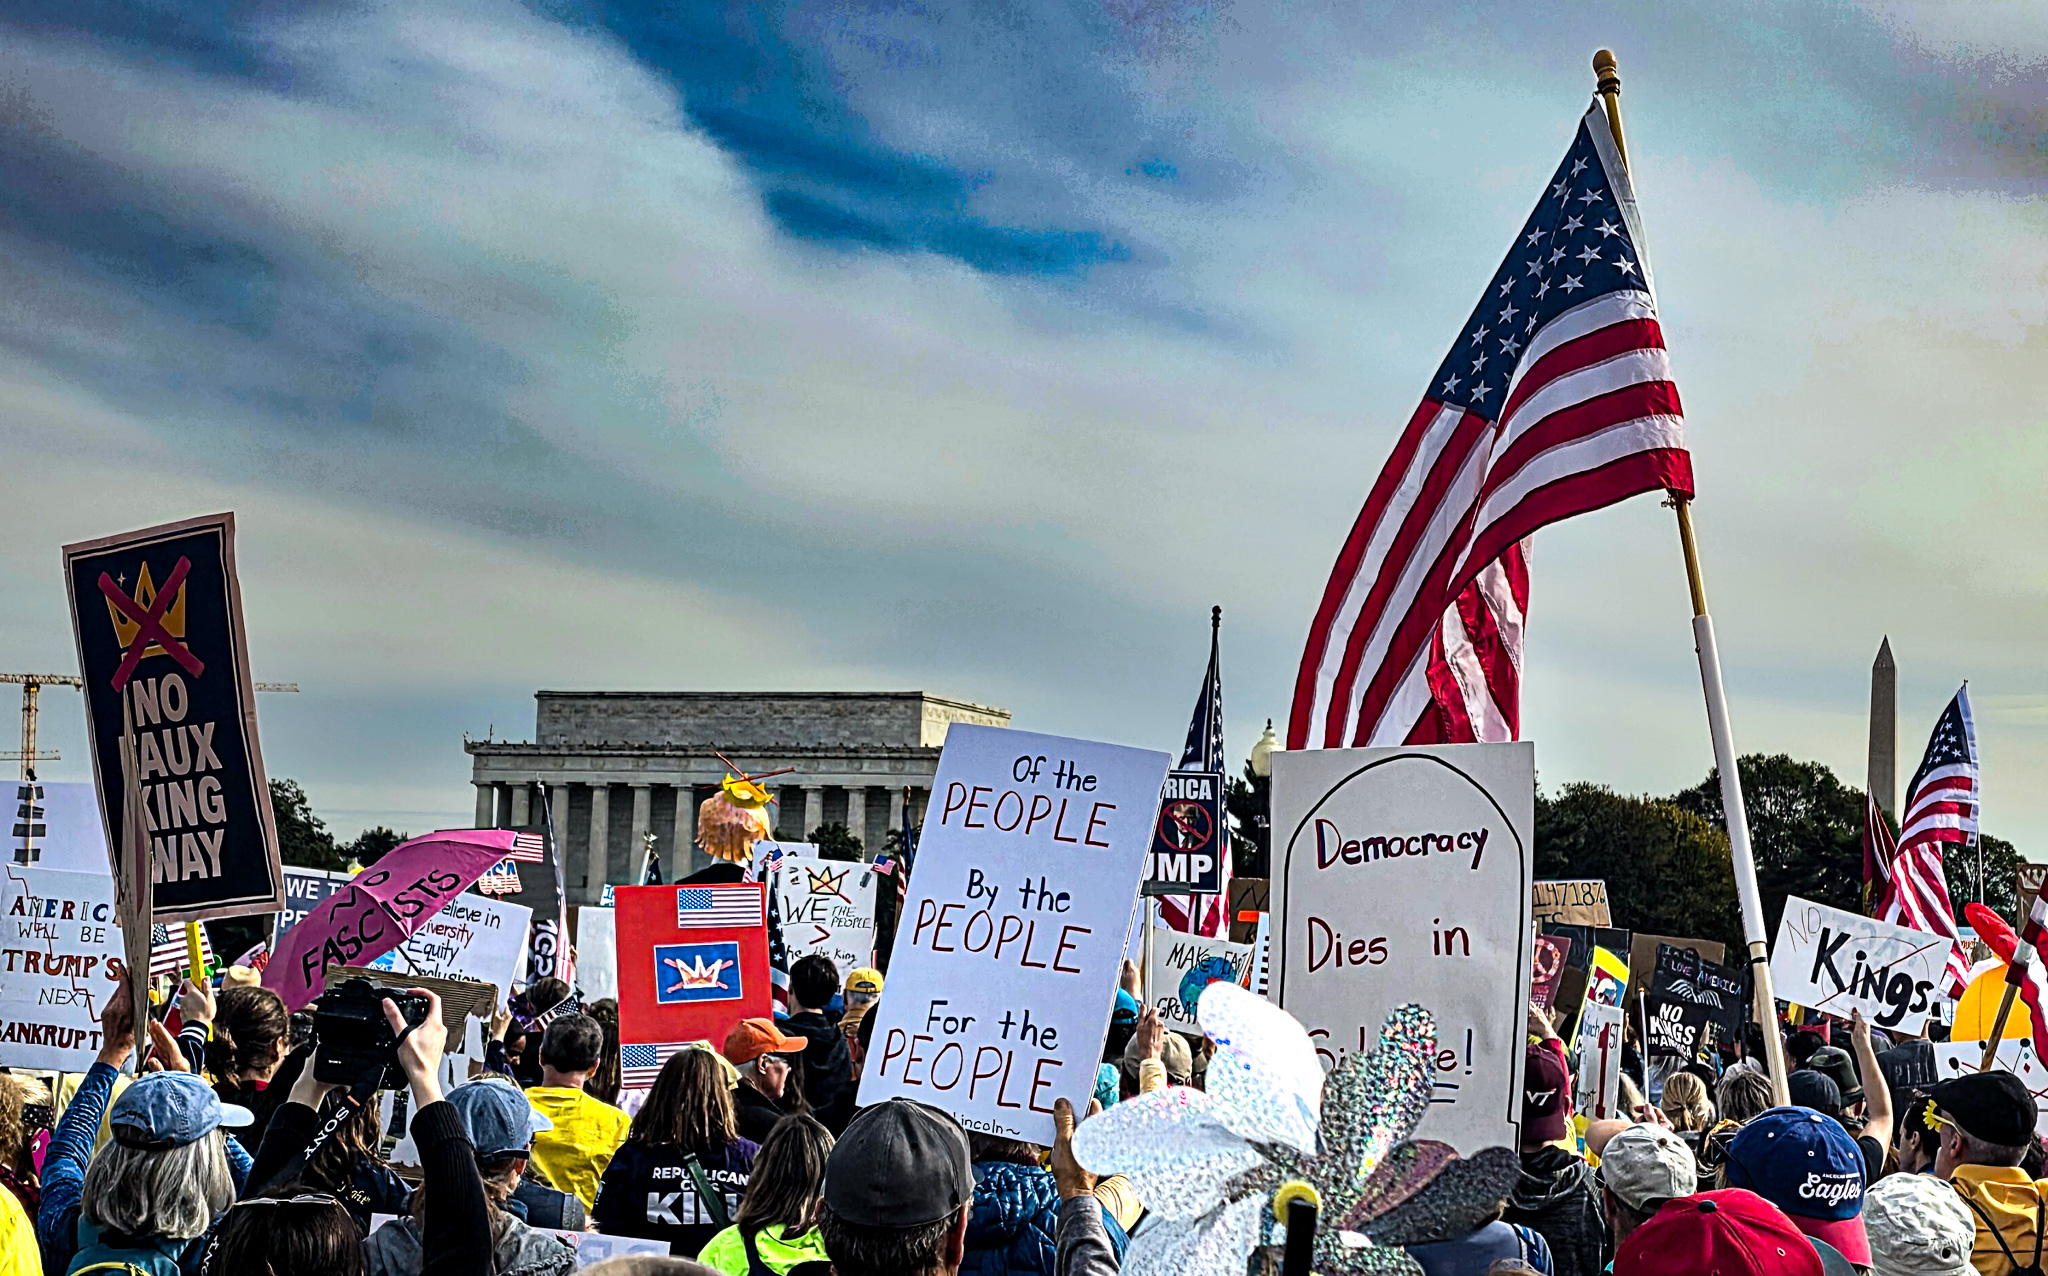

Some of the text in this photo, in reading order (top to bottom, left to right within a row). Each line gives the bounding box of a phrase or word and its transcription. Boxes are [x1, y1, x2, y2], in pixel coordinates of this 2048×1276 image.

[132, 672, 188, 727] NO
[1012, 754, 1097, 792] Of the
[1164, 777, 1212, 800] RICA
[941, 781, 1117, 848] PEOPLE
[1315, 818, 1489, 870] Democracy
[286, 877, 320, 900] WE
[966, 868, 1070, 913] By the
[9, 896, 122, 924] AMERIC
[441, 898, 501, 930] elieve in
[784, 895, 830, 923] WE
[831, 917, 871, 929] PEOPLE
[832, 905, 857, 918] THE
[18, 922, 106, 943] WILL BE
[301, 869, 461, 990] FASCISTS
[419, 919, 475, 950] iversity
[912, 898, 1092, 974] PEOPLE
[1307, 916, 1470, 973] Dies in
[1787, 906, 1822, 953] NO
[2, 949, 121, 981] TRUMP'S
[407, 931, 460, 967] Equity
[38, 987, 95, 1008] NEXT
[1660, 1003, 1684, 1022] NO
[926, 999, 1058, 1050] For the
[1648, 1036, 1659, 1045] IN
[879, 1028, 1063, 1114] PEOPLE
[1525, 1087, 1557, 1106] VT
[303, 1106, 350, 1160] SONY
[652, 1166, 750, 1187] REPULICAN
[1798, 1171, 1862, 1207] Eagles
